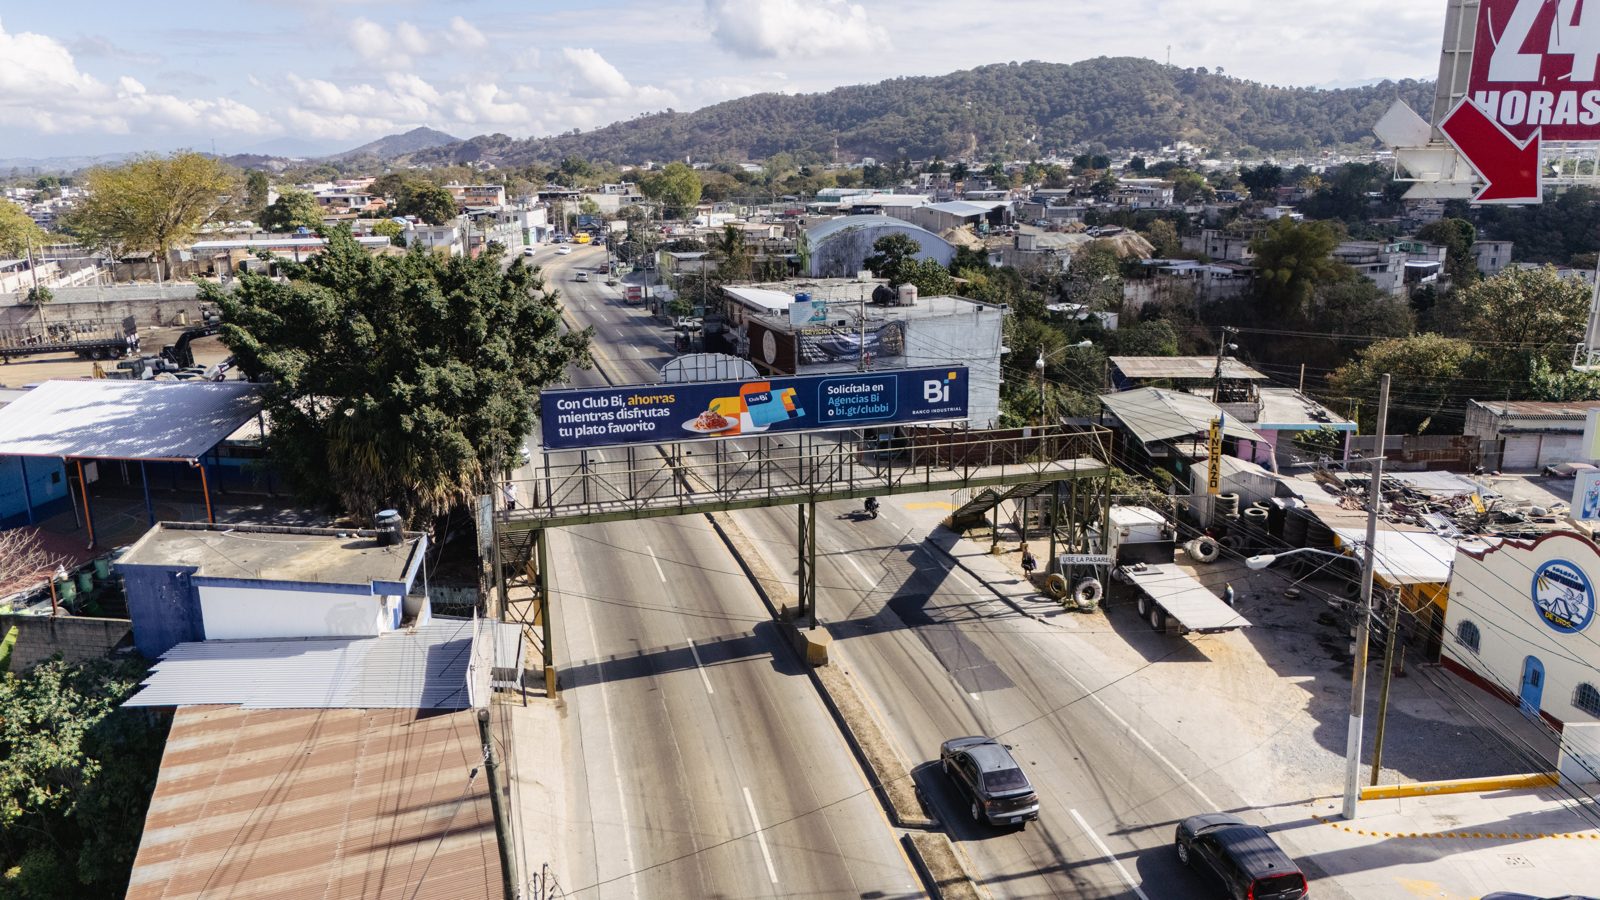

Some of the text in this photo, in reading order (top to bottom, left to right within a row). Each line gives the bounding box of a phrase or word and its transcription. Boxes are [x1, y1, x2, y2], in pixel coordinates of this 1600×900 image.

[1474, 90, 1600, 126] HORAS
[827, 384, 884, 395] Solicítala en
[924, 379, 950, 403] Bi
[557, 394, 675, 410] Con Club Bi, ahorras
[828, 393, 880, 407] Agencias Bi
[558, 407, 670, 423] mientras disfrutas
[835, 403, 889, 417] bi.gt/clubbi
[559, 420, 656, 438] tu plato favorito
